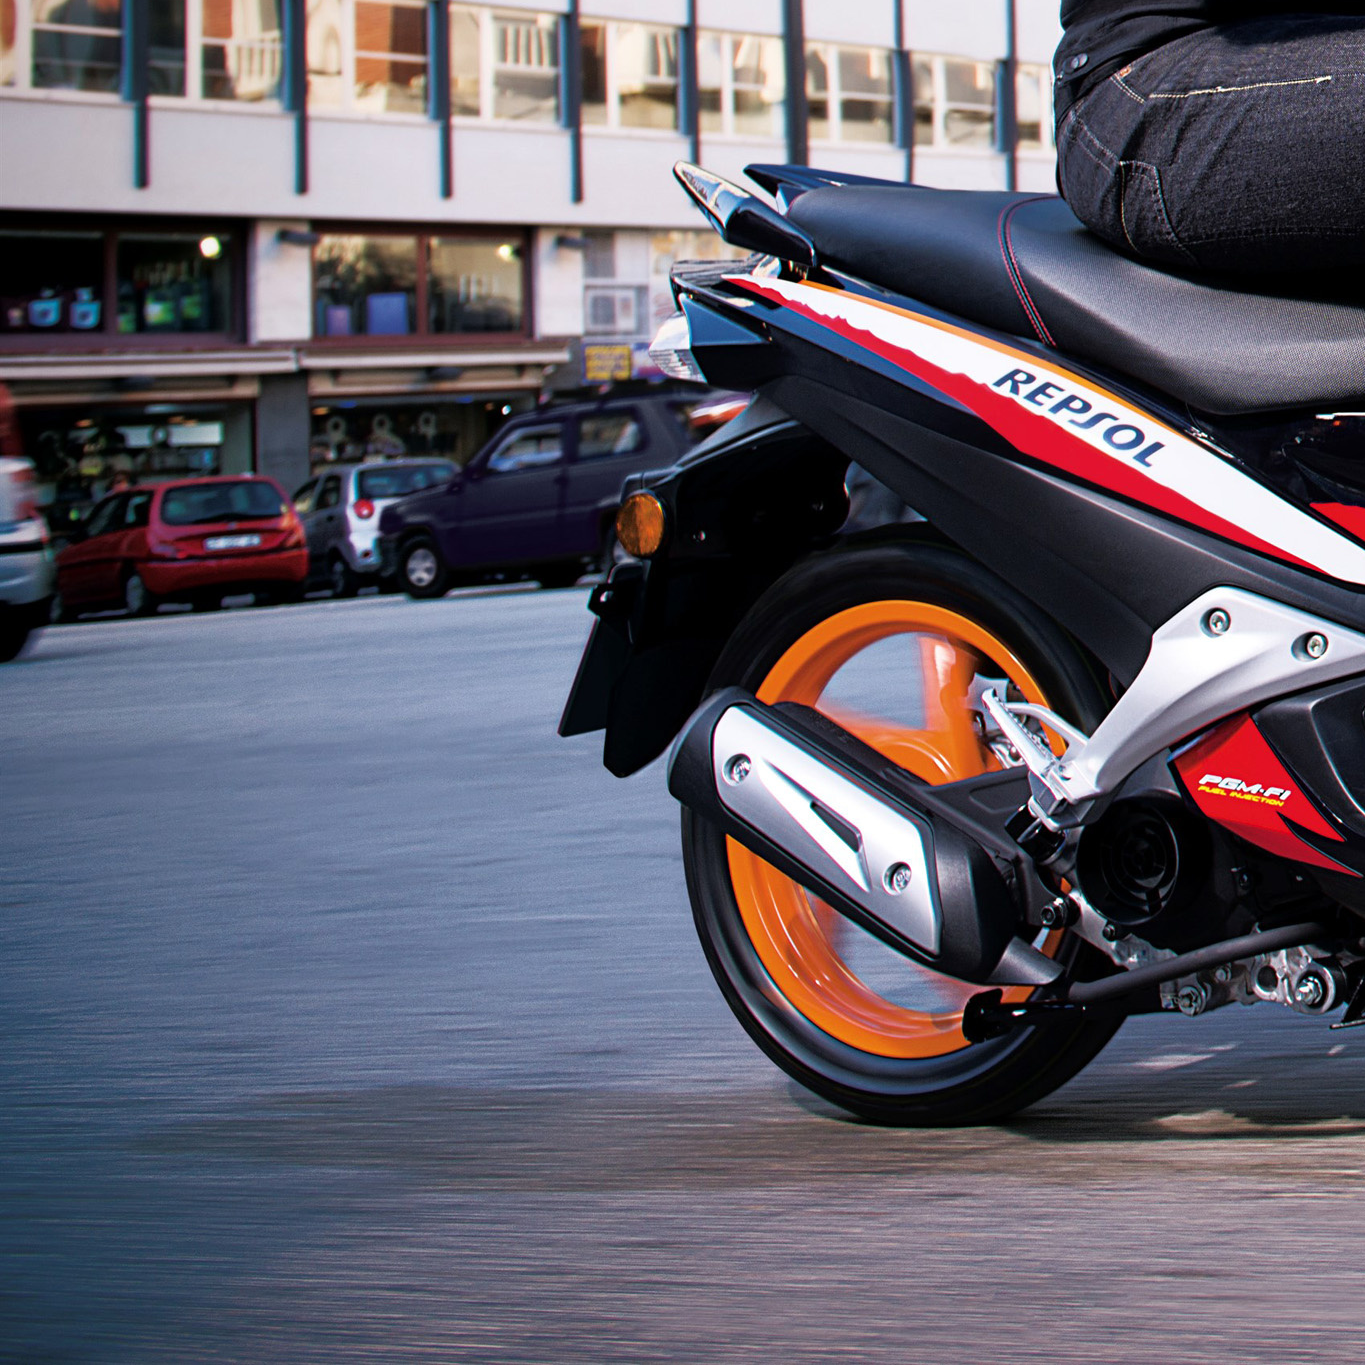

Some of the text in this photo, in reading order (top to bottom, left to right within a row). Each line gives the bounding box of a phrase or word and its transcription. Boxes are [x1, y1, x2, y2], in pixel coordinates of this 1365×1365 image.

[992, 368, 1165, 468] REPSOL
[1198, 785, 1284, 807] FUEL INJECTION
